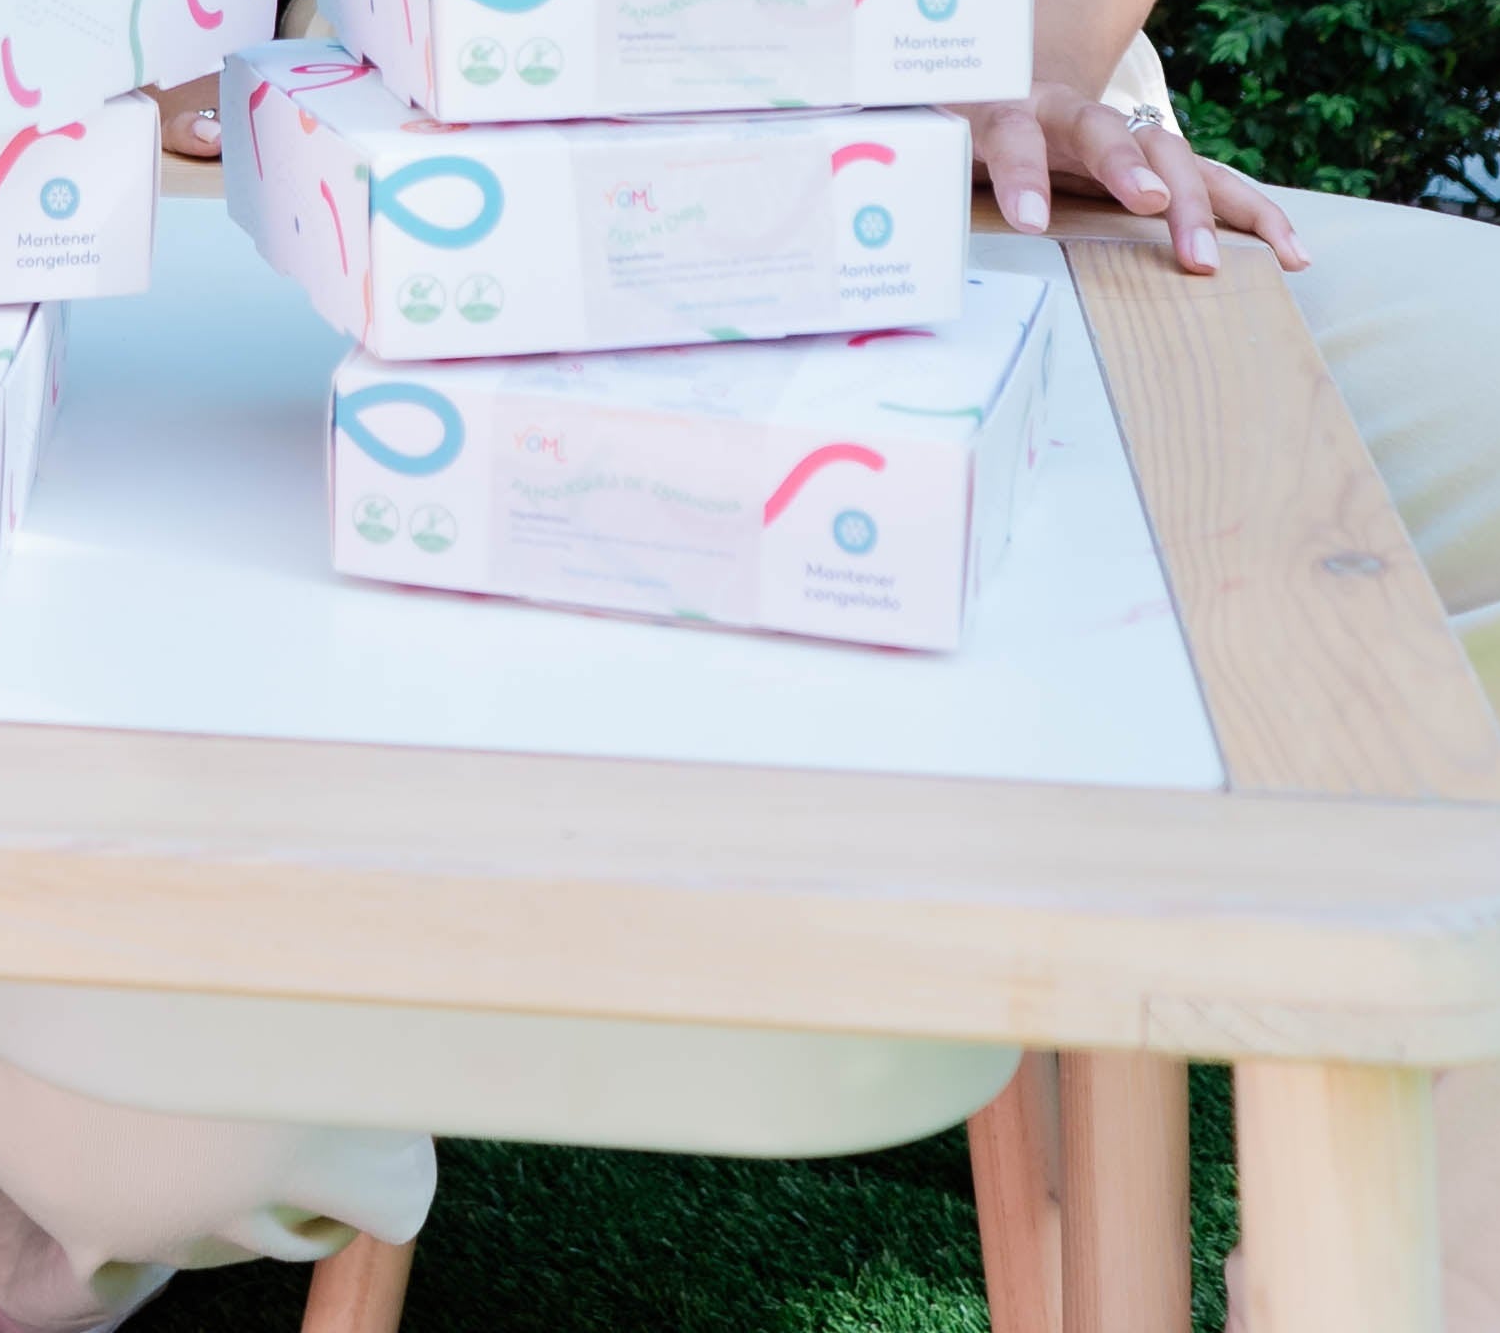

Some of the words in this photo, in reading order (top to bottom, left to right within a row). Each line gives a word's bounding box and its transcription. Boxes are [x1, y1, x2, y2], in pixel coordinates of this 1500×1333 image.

[894, 34, 977, 50] Mantener
[893, 55, 982, 74] congelado
[17, 232, 96, 248] Mantener
[16, 250, 101, 270] congelado
[840, 281, 917, 302] ongelado
[805, 562, 897, 589] Mantener
[803, 589, 902, 613] congelado
